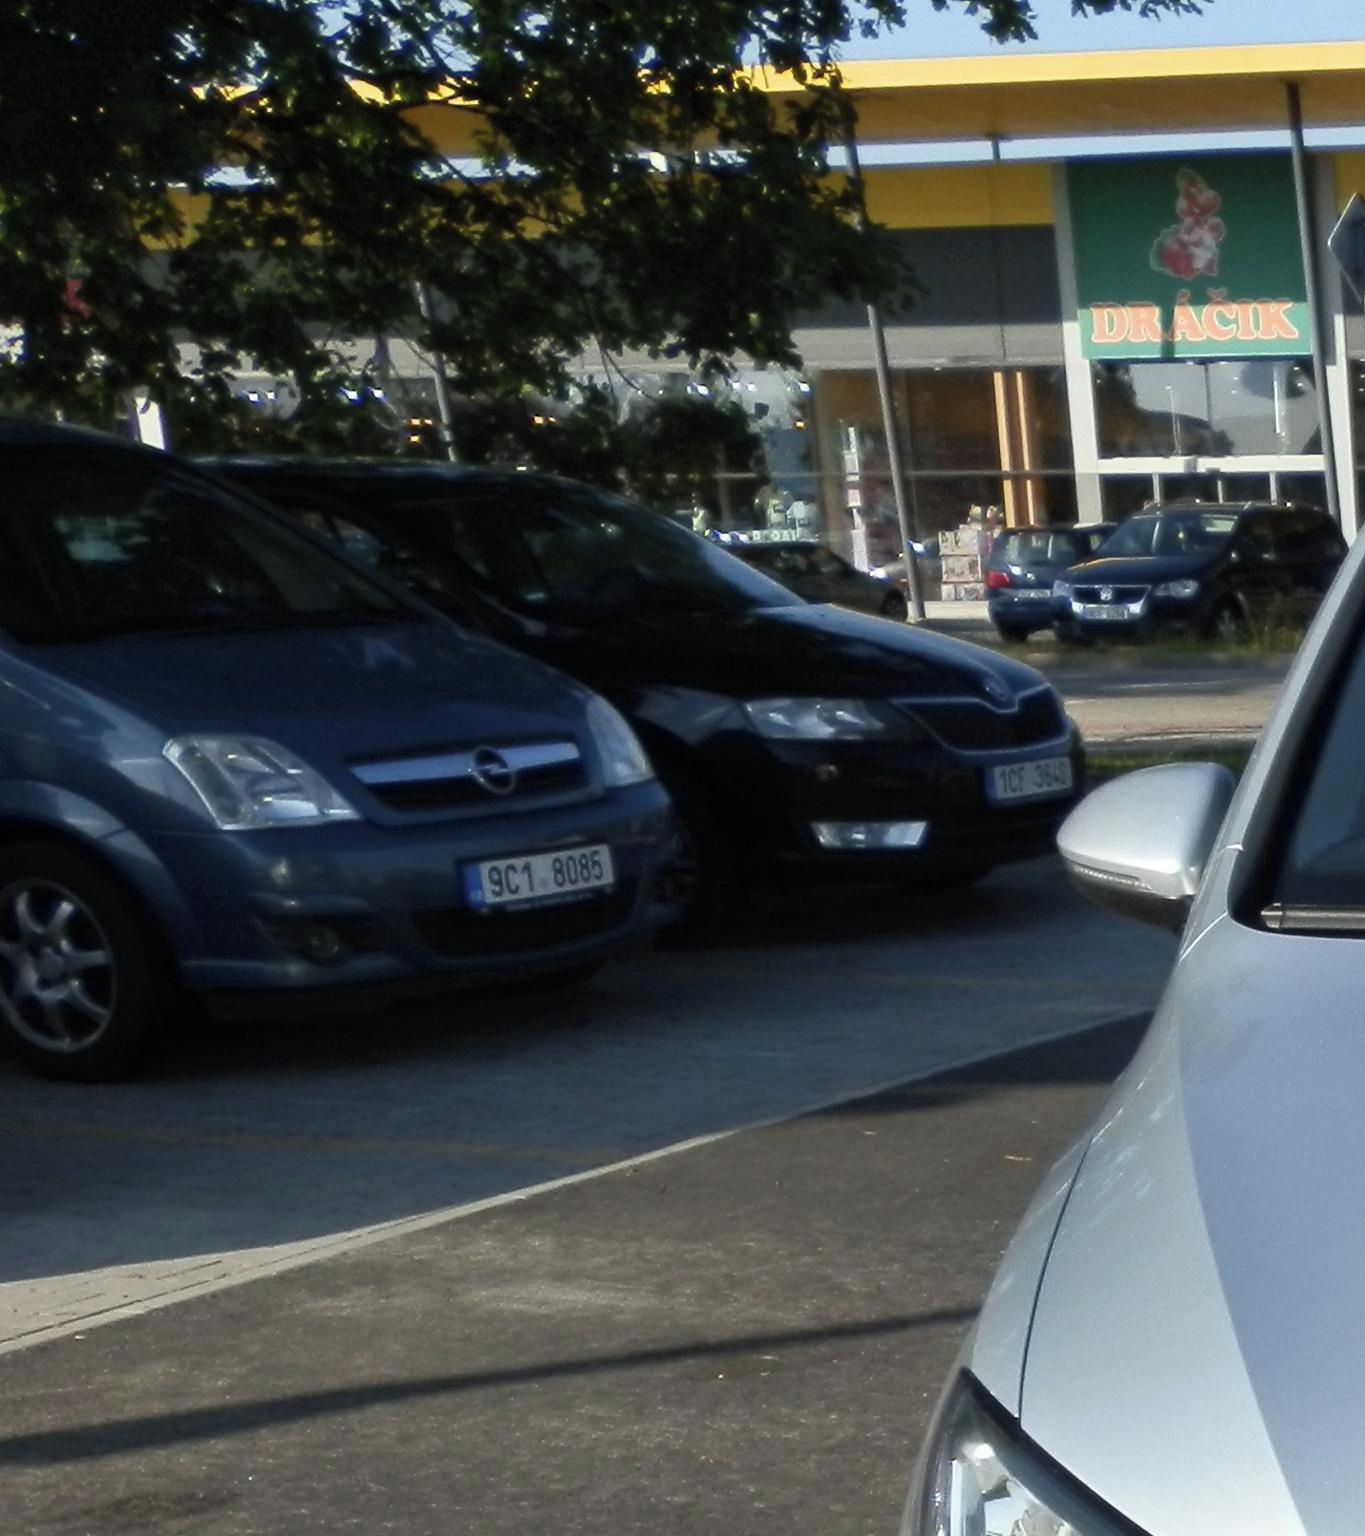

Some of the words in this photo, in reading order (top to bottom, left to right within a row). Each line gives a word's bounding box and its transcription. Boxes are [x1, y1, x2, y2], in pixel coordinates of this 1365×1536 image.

[1089, 288, 1299, 343] DRÁČIK
[487, 861, 534, 897] 9C1
[551, 850, 604, 888] 8085
